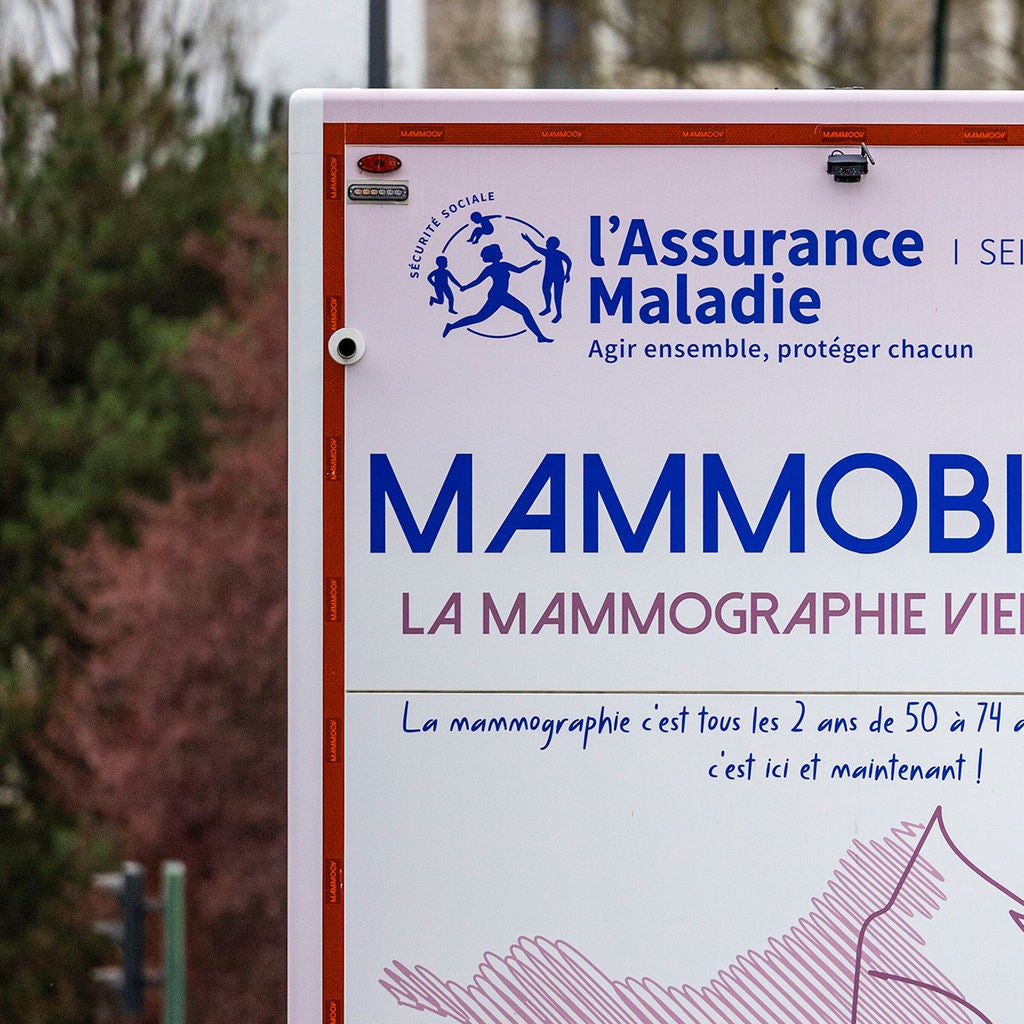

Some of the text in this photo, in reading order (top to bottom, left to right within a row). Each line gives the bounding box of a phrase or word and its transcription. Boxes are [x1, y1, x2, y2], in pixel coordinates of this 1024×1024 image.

[401, 130, 443, 138] MAMMOOV
[541, 130, 583, 138] MAMMOOV
[681, 130, 724, 138] MAMMOOV
[822, 131, 866, 139] MAMMOOV
[963, 131, 1007, 139] MAMMOOV
[330, 155, 338, 199] MAMMOOV
[408, 191, 495, 279] SÉCURITÉ SOCIALE
[589, 215, 924, 267] l’Assurance
[589, 272, 821, 325] Maladie
[588, 338, 973, 364] Agir ensemble, protéger chacun
[330, 578, 338, 621] MAMMOOV
[403, 592, 461, 634] LA
[483, 592, 926, 635] MAMMOGRAPHIE
[330, 719, 338, 762] MAMMOOV
[402, 701, 438, 733] La
[450, 706, 631, 750] mammographie
[641, 703, 689, 733] c'est
[699, 706, 740, 733] tous
[752, 707, 779, 733] les
[791, 700, 806, 733] 2
[817, 717, 857, 733] ans
[868, 706, 894, 733] de
[906, 701, 938, 733] 50
[949, 711, 966, 733] à
[977, 701, 1002, 732] 74
[708, 750, 755, 780] c'est
[765, 757, 789, 779] ici
[799, 753, 820, 780] et
[831, 753, 966, 781] maintenant
[330, 860, 338, 903] MAMMOOV
